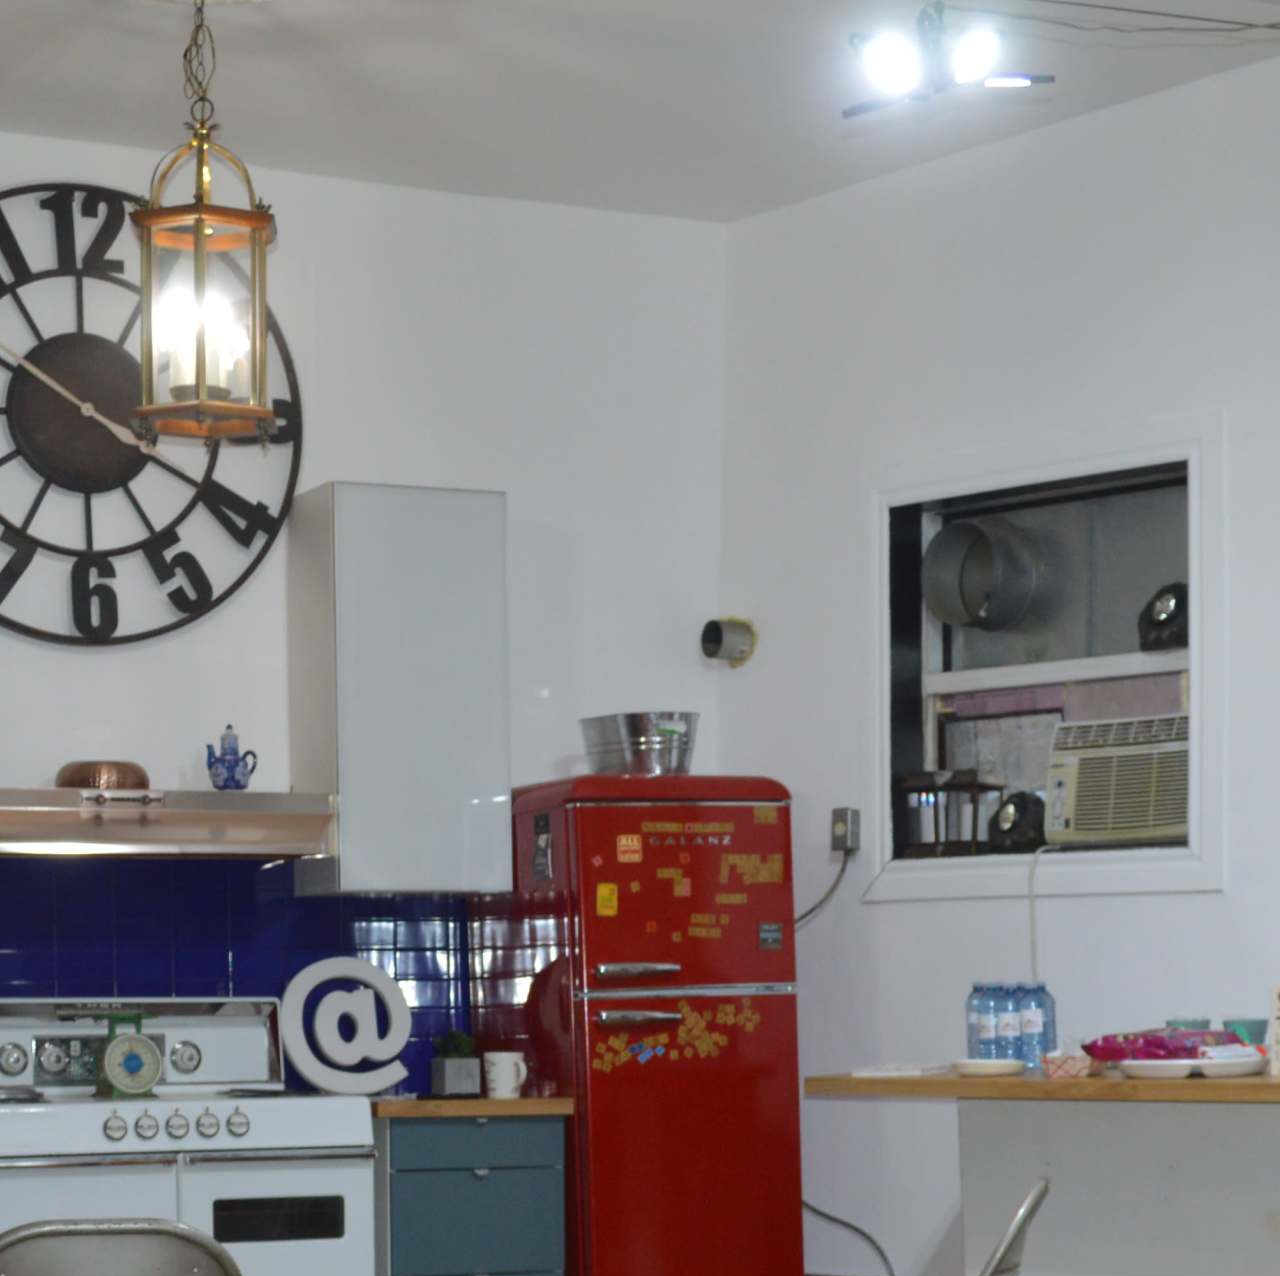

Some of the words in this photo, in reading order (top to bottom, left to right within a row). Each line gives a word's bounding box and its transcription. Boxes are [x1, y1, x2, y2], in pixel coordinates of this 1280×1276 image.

[39, 190, 126, 275] 12
[200, 478, 278, 549] 4
[70, 554, 119, 639] 6
[144, 528, 213, 613] 5
[280, 956, 412, 1096] @
